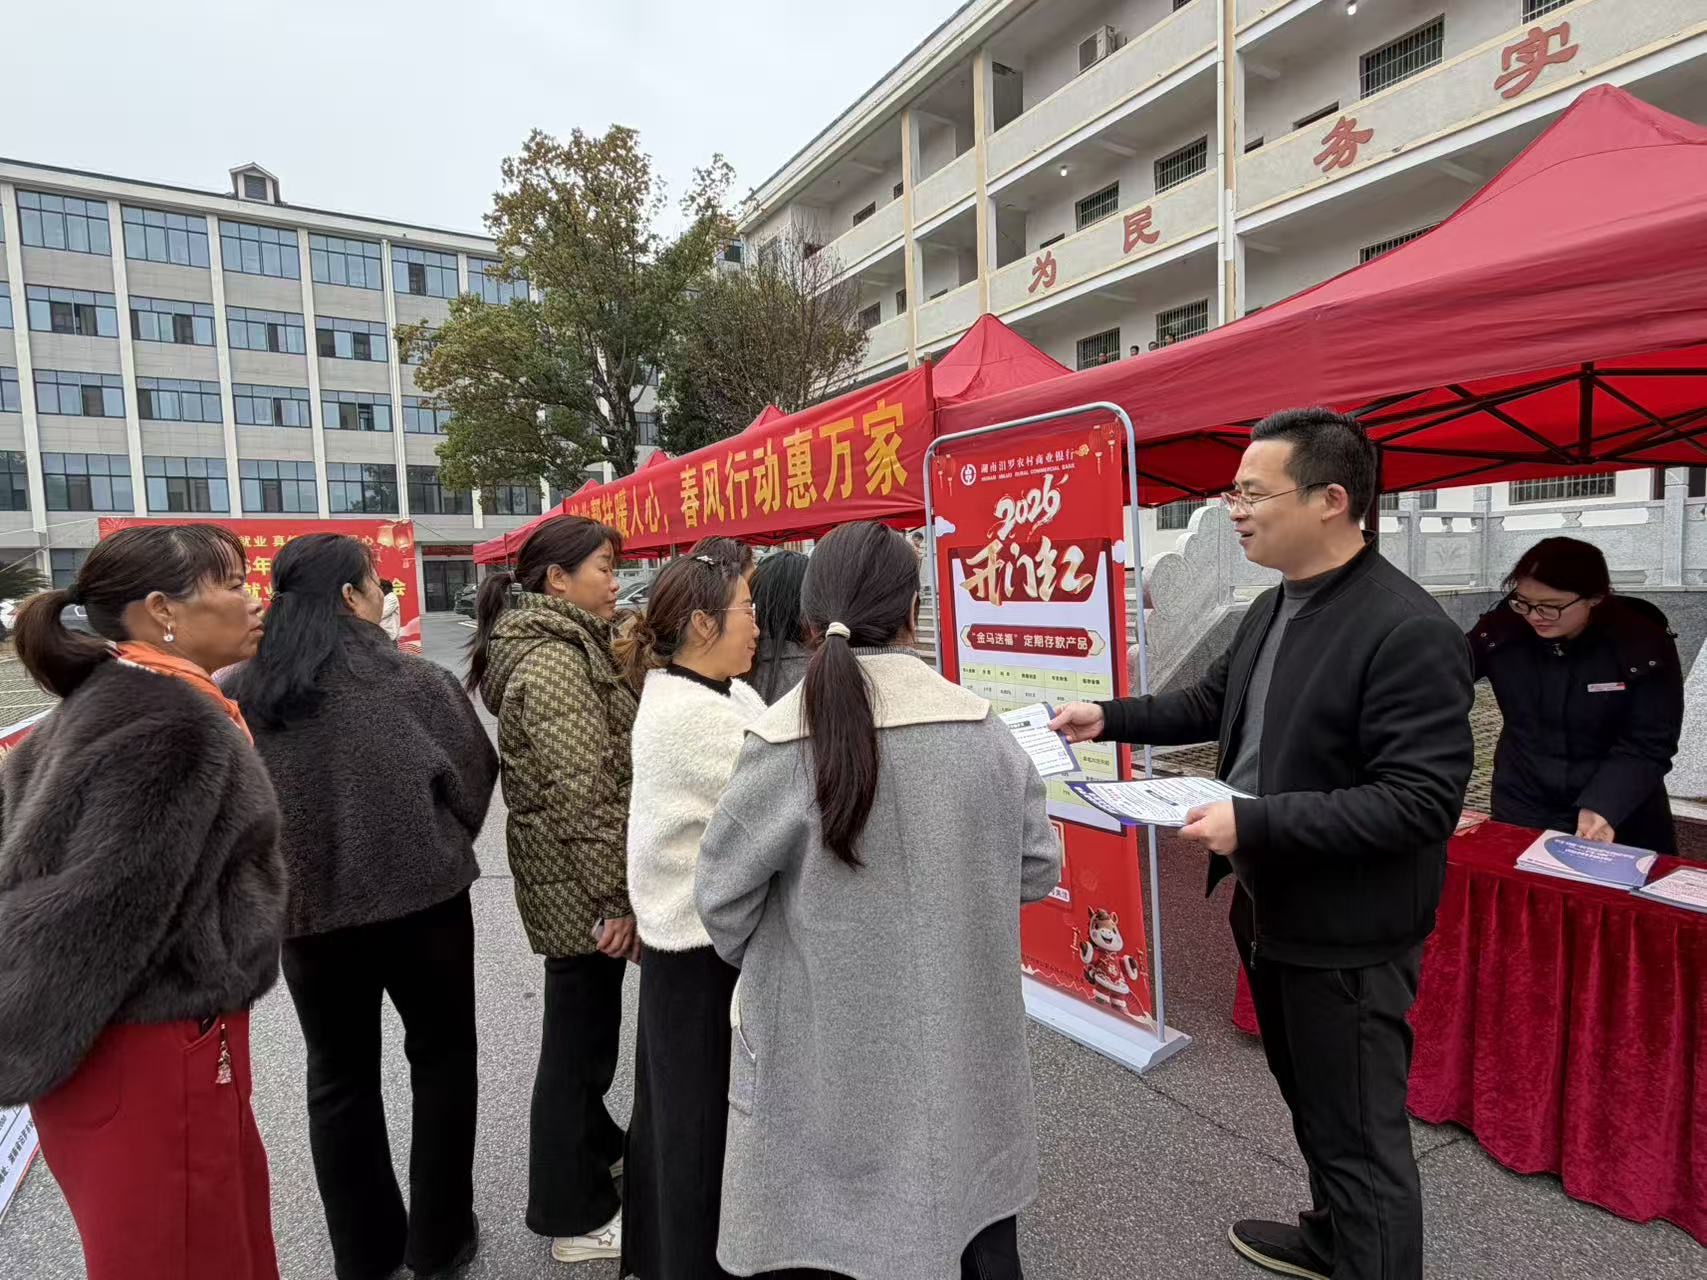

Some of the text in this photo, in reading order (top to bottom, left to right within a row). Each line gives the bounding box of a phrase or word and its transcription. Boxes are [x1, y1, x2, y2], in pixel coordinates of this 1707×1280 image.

[993, 474, 1068, 540] 2026
[1023, 635, 1088, 650] 定期存款产品
